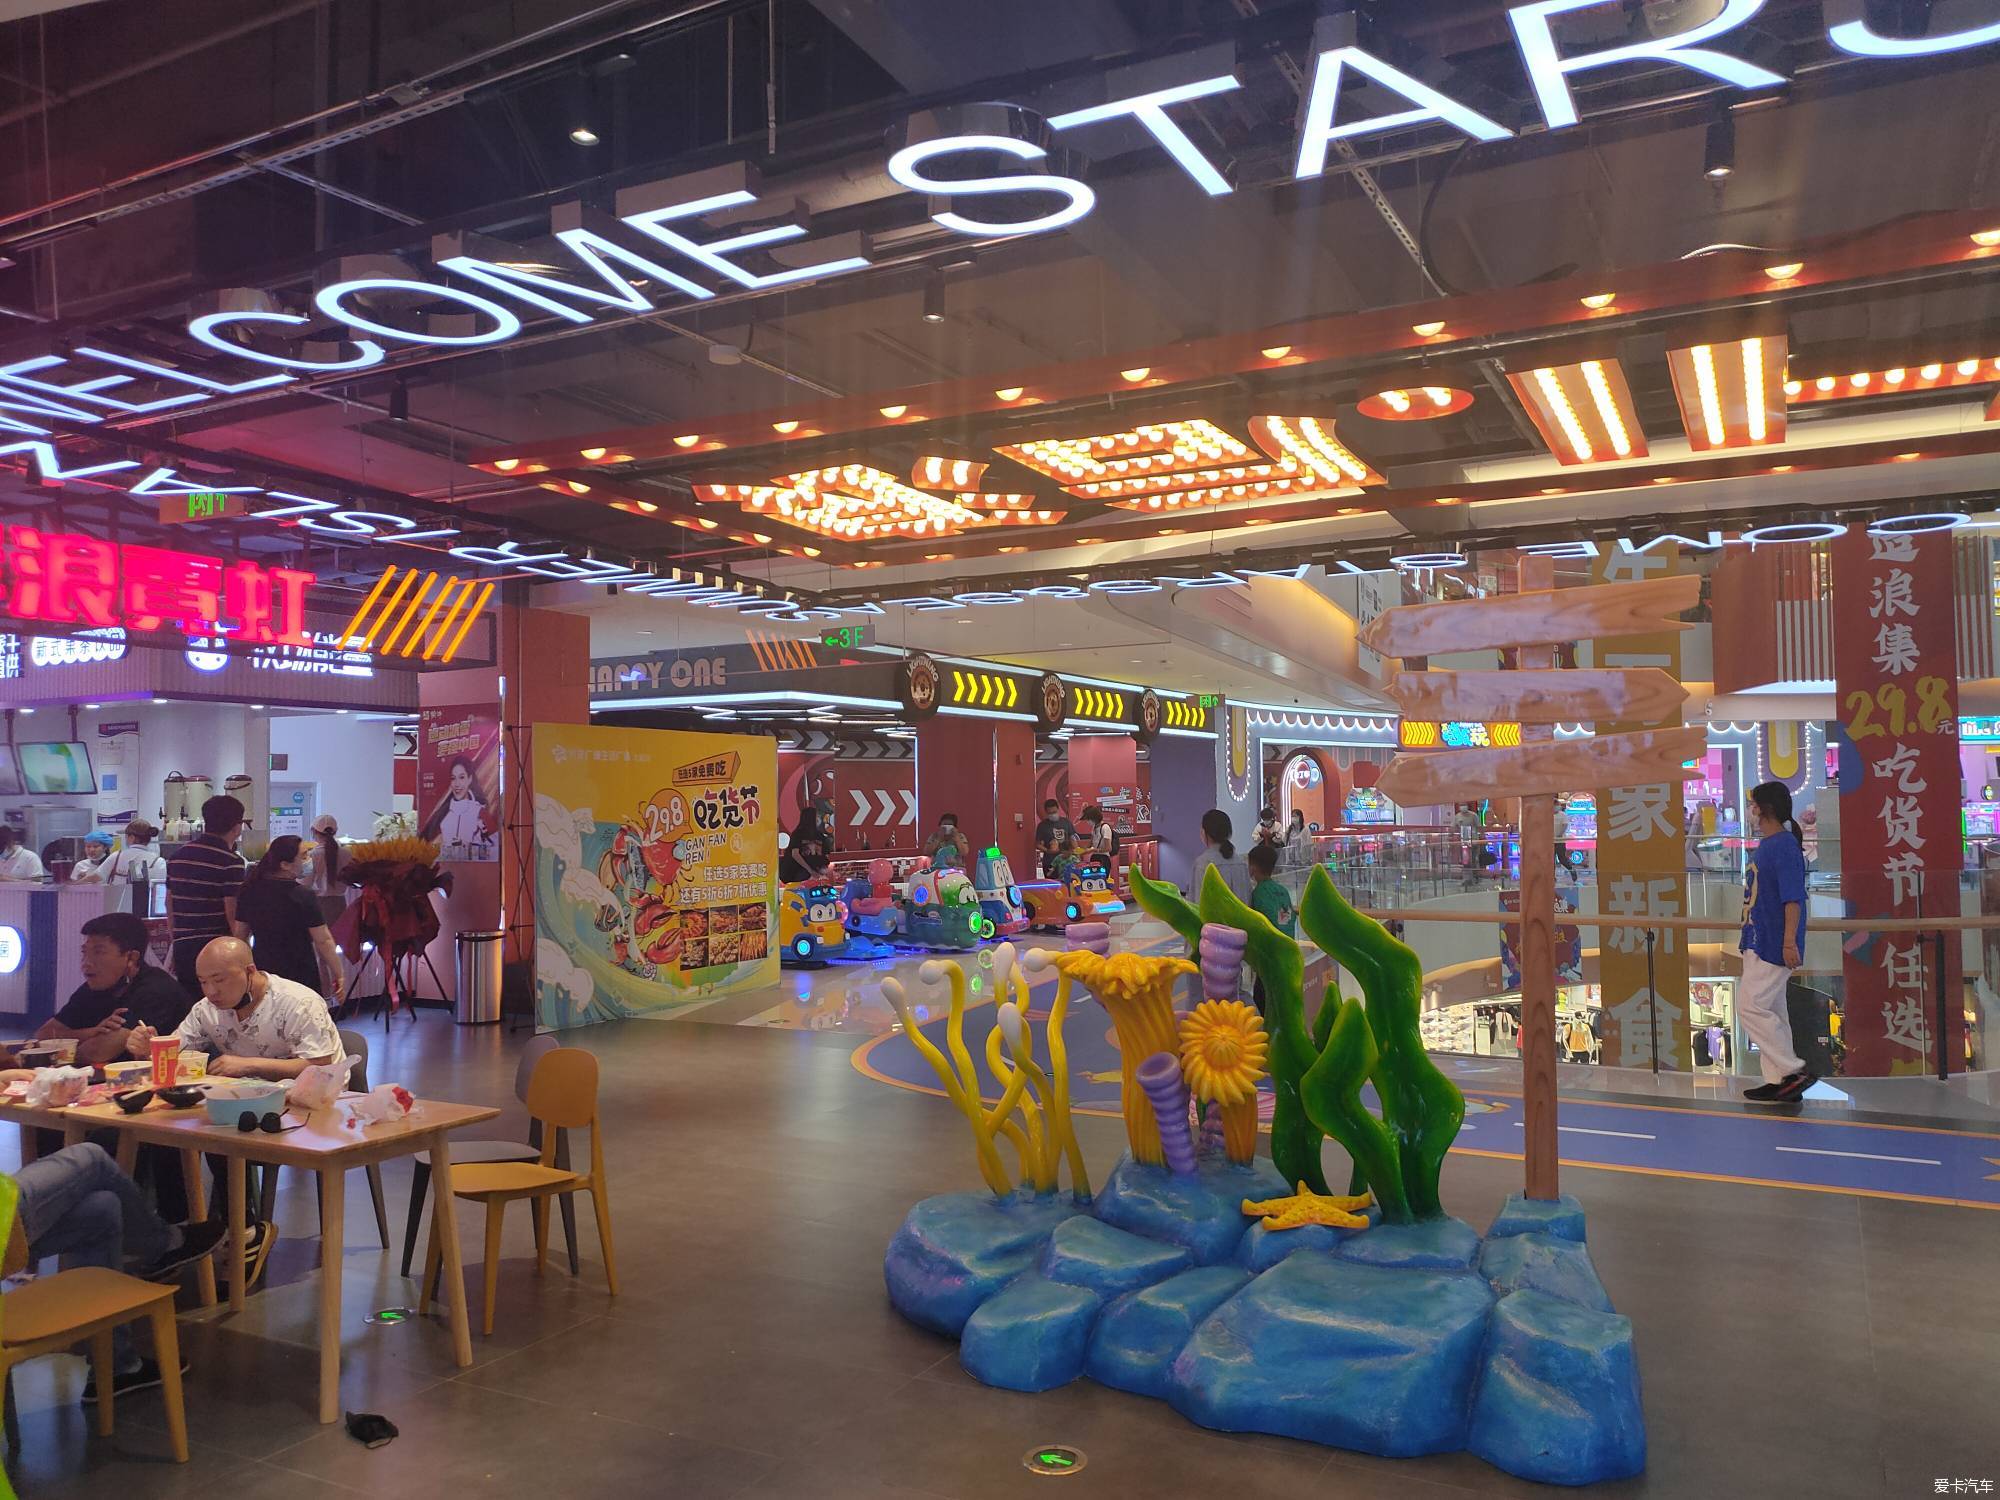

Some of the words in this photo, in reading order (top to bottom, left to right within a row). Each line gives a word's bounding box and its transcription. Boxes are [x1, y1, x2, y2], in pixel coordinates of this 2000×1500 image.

[0, 523, 317, 648] 浪霓虹
[670, 657, 726, 688] ONE
[643, 796, 684, 842] 29.8
[693, 783, 761, 829] 吃货节
[685, 836, 705, 851] GAN
[707, 832, 727, 846] FAN
[704, 862, 767, 882] 任选5家免费吃
[680, 882, 767, 903] 还有5折6折7折优惠
